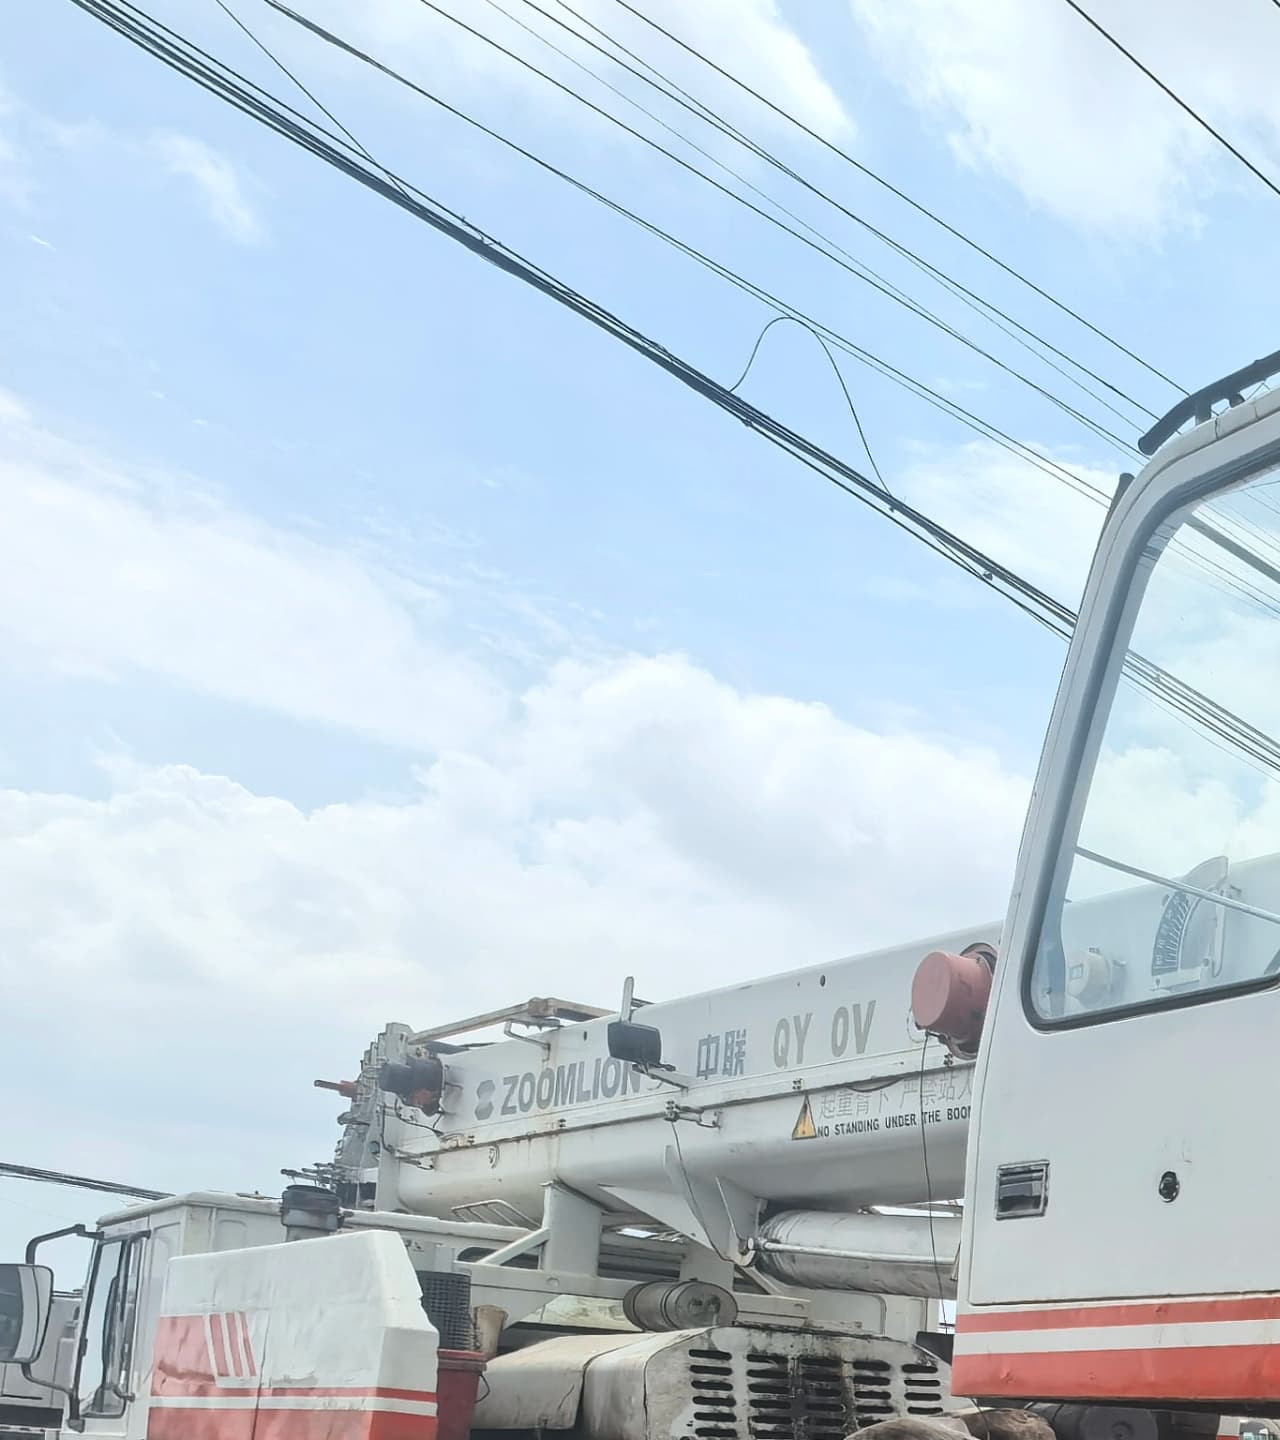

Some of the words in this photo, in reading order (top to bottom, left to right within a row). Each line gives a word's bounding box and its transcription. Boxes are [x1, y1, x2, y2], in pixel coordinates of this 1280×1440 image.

[773, 1012, 813, 1069] QY
[501, 1056, 641, 1115] ZOOMLION
[817, 1126, 830, 1138] NO
[834, 1118, 880, 1135] STANDING
[885, 1112, 917, 1129] UNDER
[921, 1110, 941, 1124] THE
